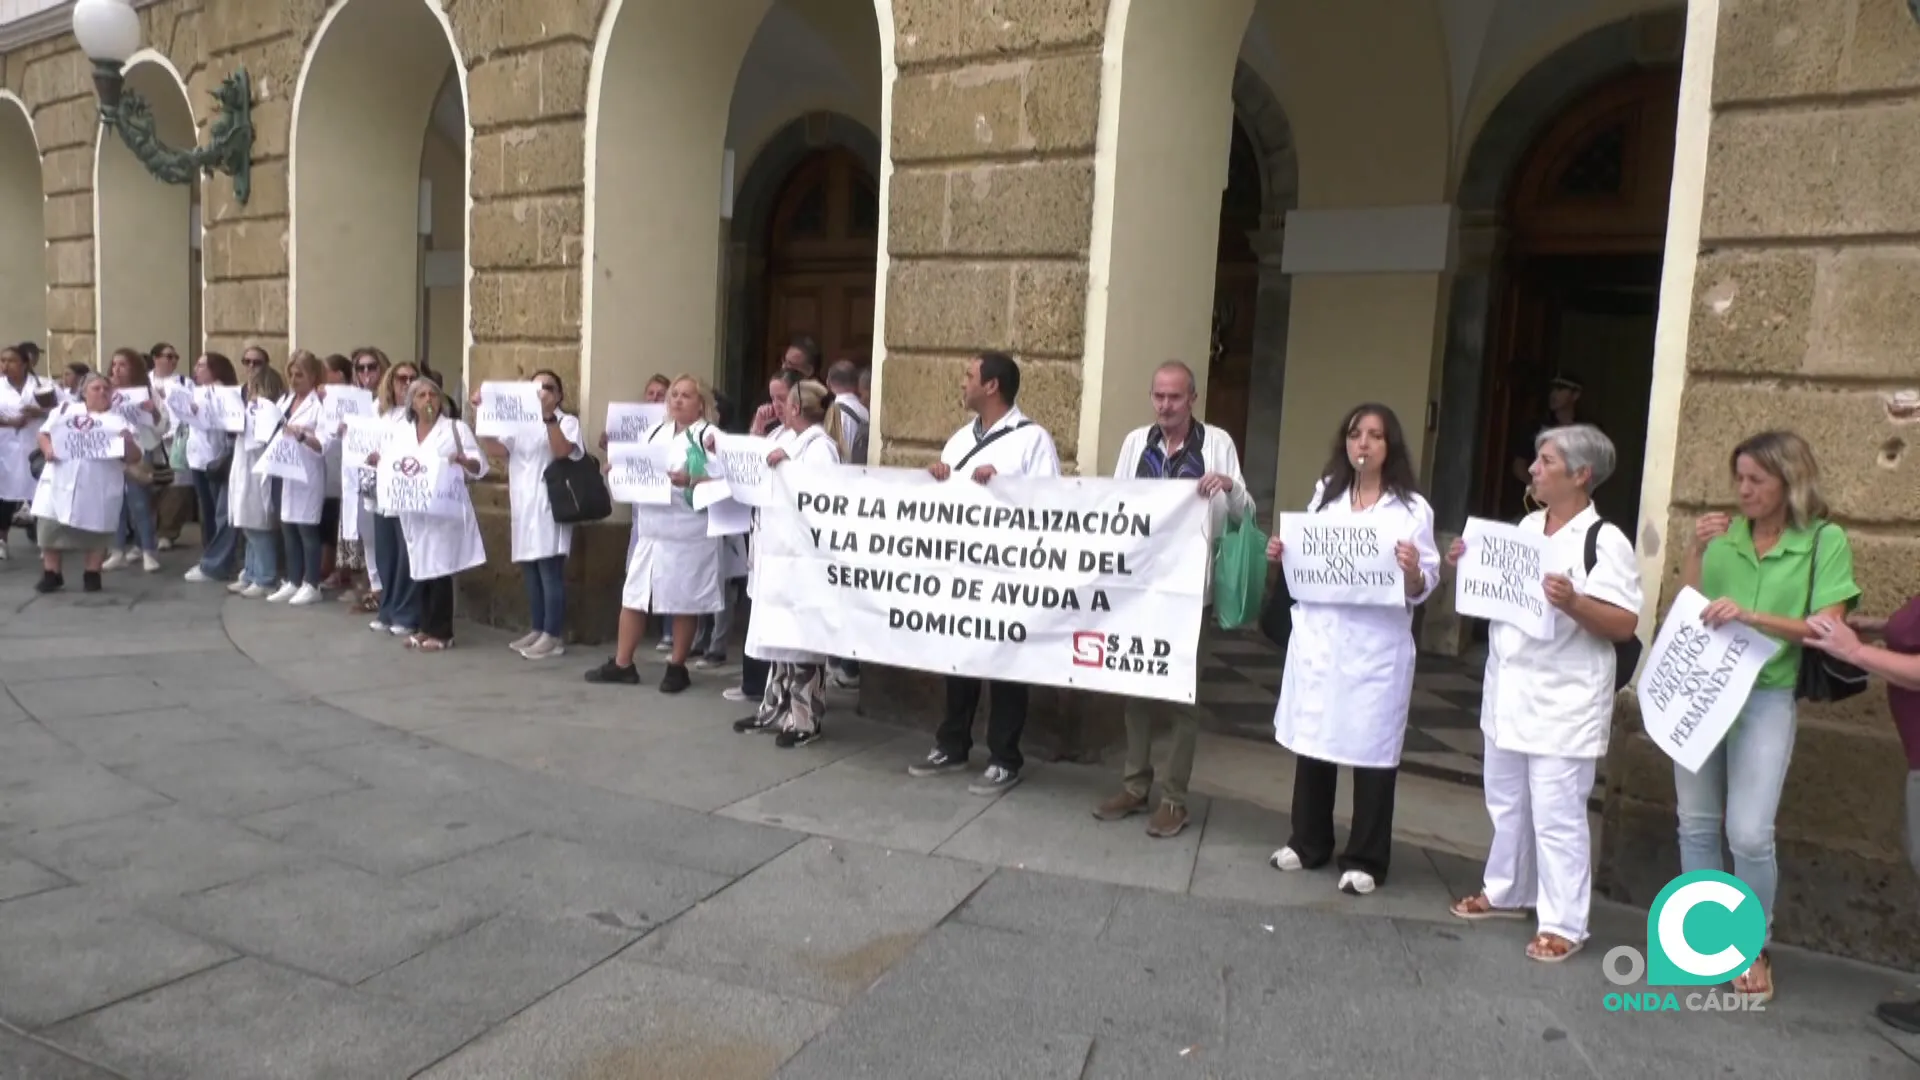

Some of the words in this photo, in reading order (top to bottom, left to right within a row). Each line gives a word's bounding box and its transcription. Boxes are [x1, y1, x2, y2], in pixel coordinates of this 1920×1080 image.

[797, 491, 849, 516] POR
[857, 496, 887, 520] LA
[896, 499, 1151, 538] MUNICIPALIZACIÓN
[810, 527, 822, 549] Y
[829, 529, 859, 553] LA
[868, 532, 1067, 572] DIGNIFICACIÓN
[1078, 549, 1133, 576] DEL
[1302, 526, 1378, 541] NUESTROS
[1302, 540, 1380, 557] DERECHOS
[1481, 535, 1541, 562] NUESTROS
[1293, 568, 1396, 587] PERMANENTES
[1324, 555, 1356, 571] SON
[1480, 550, 1541, 582] DERECHOS
[1501, 570, 1525, 591] SON
[827, 563, 942, 597] SERVICIO
[951, 577, 984, 601] DE
[991, 581, 1080, 611] AYUDA
[1090, 589, 1111, 612] A
[1463, 577, 1544, 618] PERMANENTES
[889, 607, 1027, 643] DOMICILIO
[1105, 652, 1170, 677] CÁDIZ
[1646, 620, 1694, 701] NUESTROS
[1653, 628, 1712, 713] DERECHOS
[1669, 633, 1751, 749] PERMANENTES
[1678, 663, 1711, 701] SON
